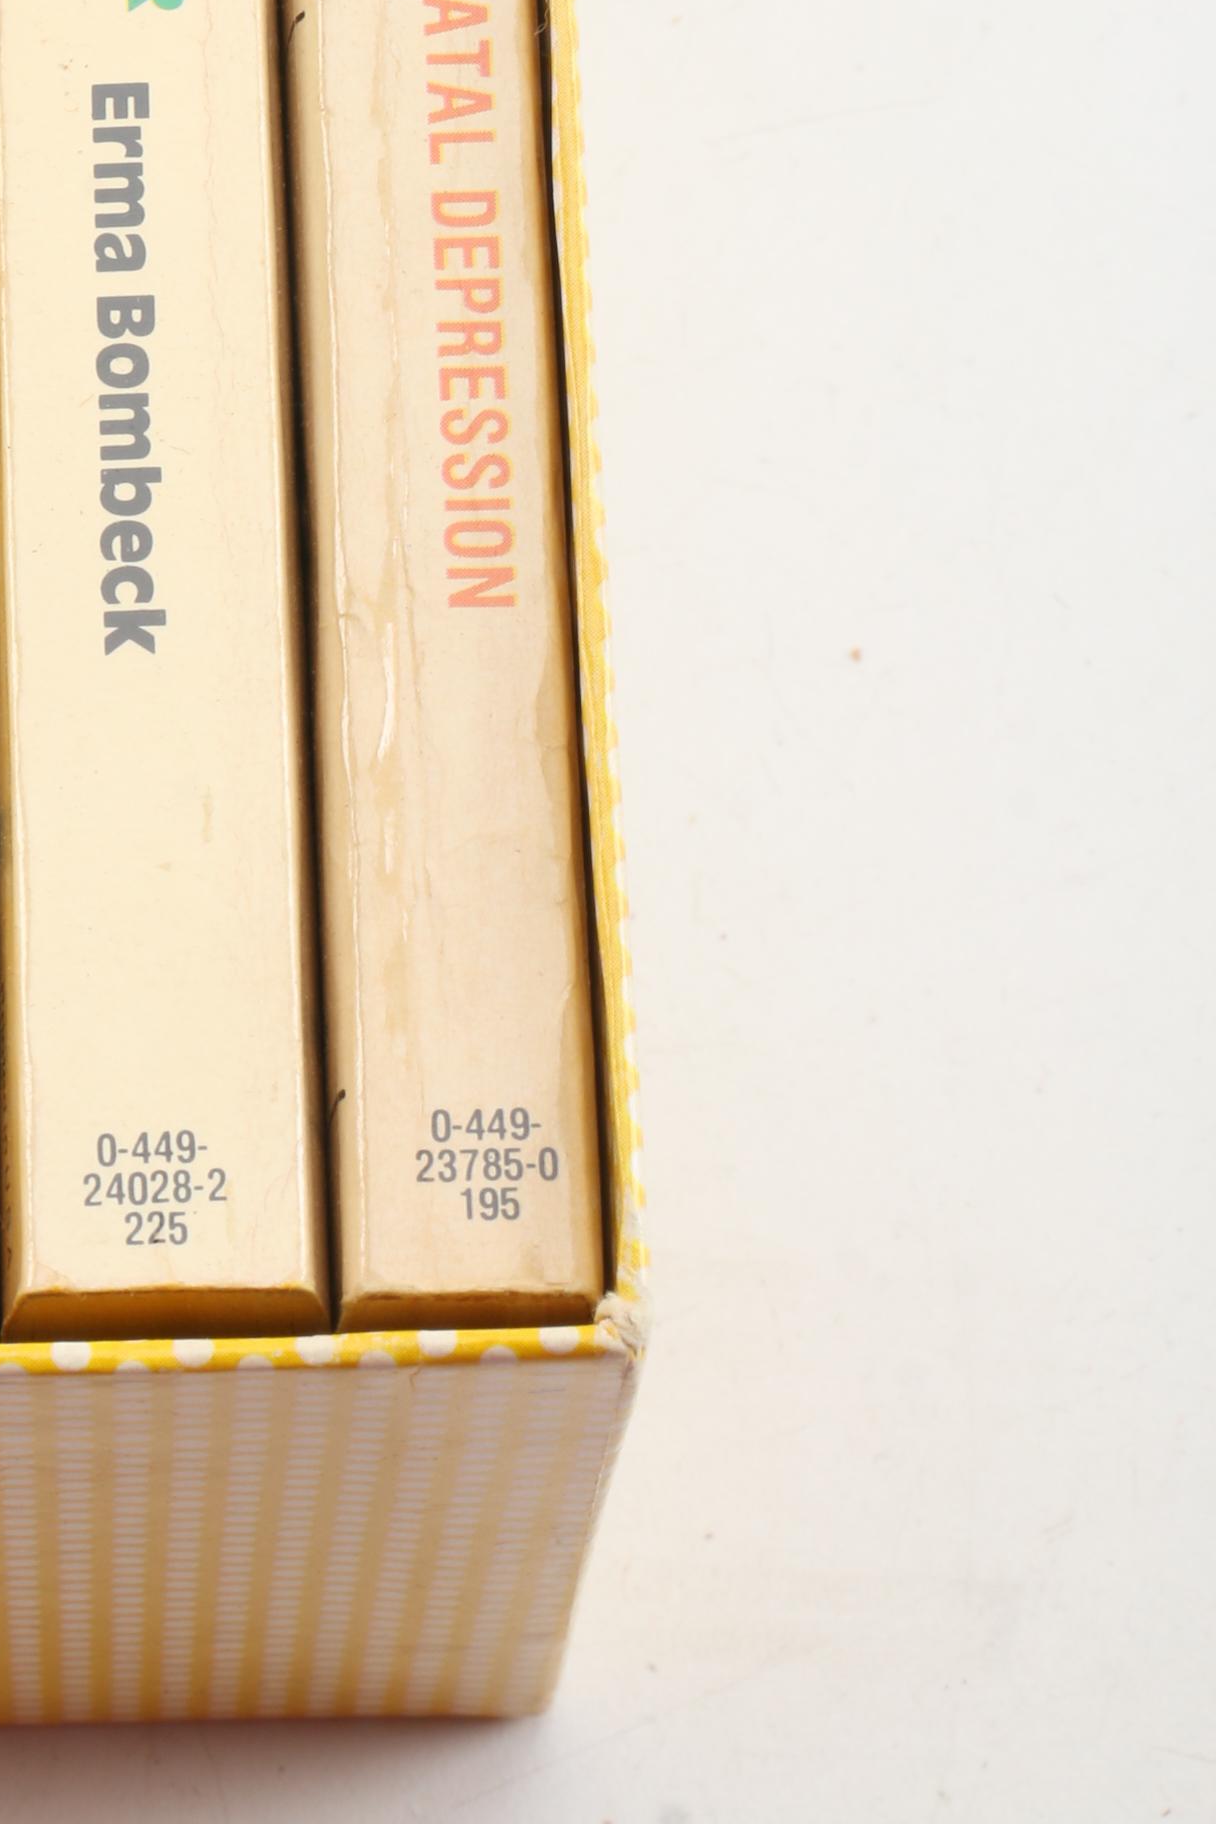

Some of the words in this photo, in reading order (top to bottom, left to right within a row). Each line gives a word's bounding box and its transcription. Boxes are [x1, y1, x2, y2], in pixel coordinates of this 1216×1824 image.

[91, 82, 150, 273] Erma
[431, 190, 517, 608] DEPRESSION
[95, 294, 166, 656] Bombeck
[431, 1107, 542, 1143] 0-449-
[97, 1129, 208, 1167] 0-449-
[415, 1147, 559, 1182] 23785-0
[83, 1168, 228, 1206] 24028-2
[460, 1187, 520, 1220] 195
[124, 1211, 188, 1245] 225
